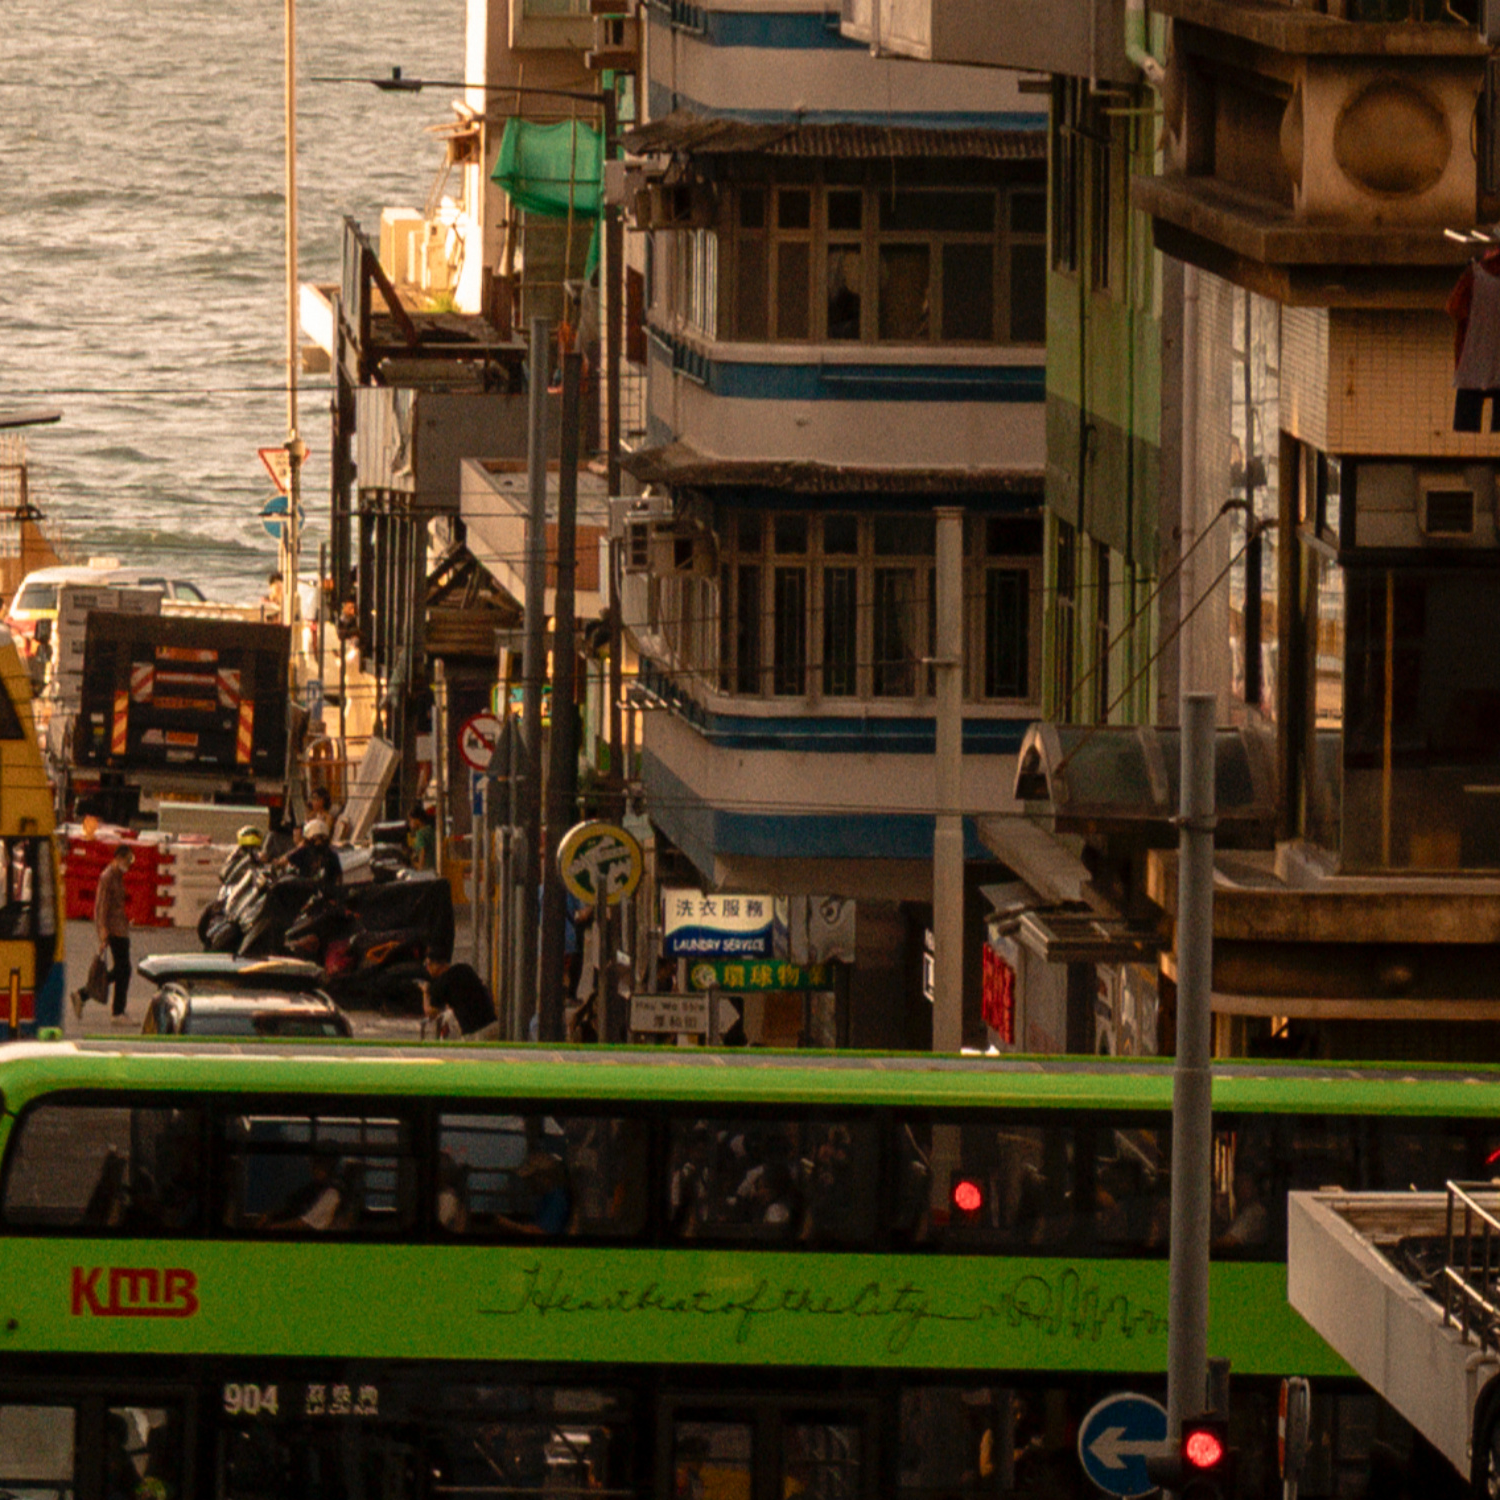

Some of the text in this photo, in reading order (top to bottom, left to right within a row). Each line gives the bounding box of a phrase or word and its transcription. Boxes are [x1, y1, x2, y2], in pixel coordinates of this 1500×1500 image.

[676, 898, 763, 917] 洗衣服務
[672, 937, 766, 953] LAUNDRY SERVICE
[71, 1266, 198, 1317] KMB
[223, 1384, 278, 1416] 904
